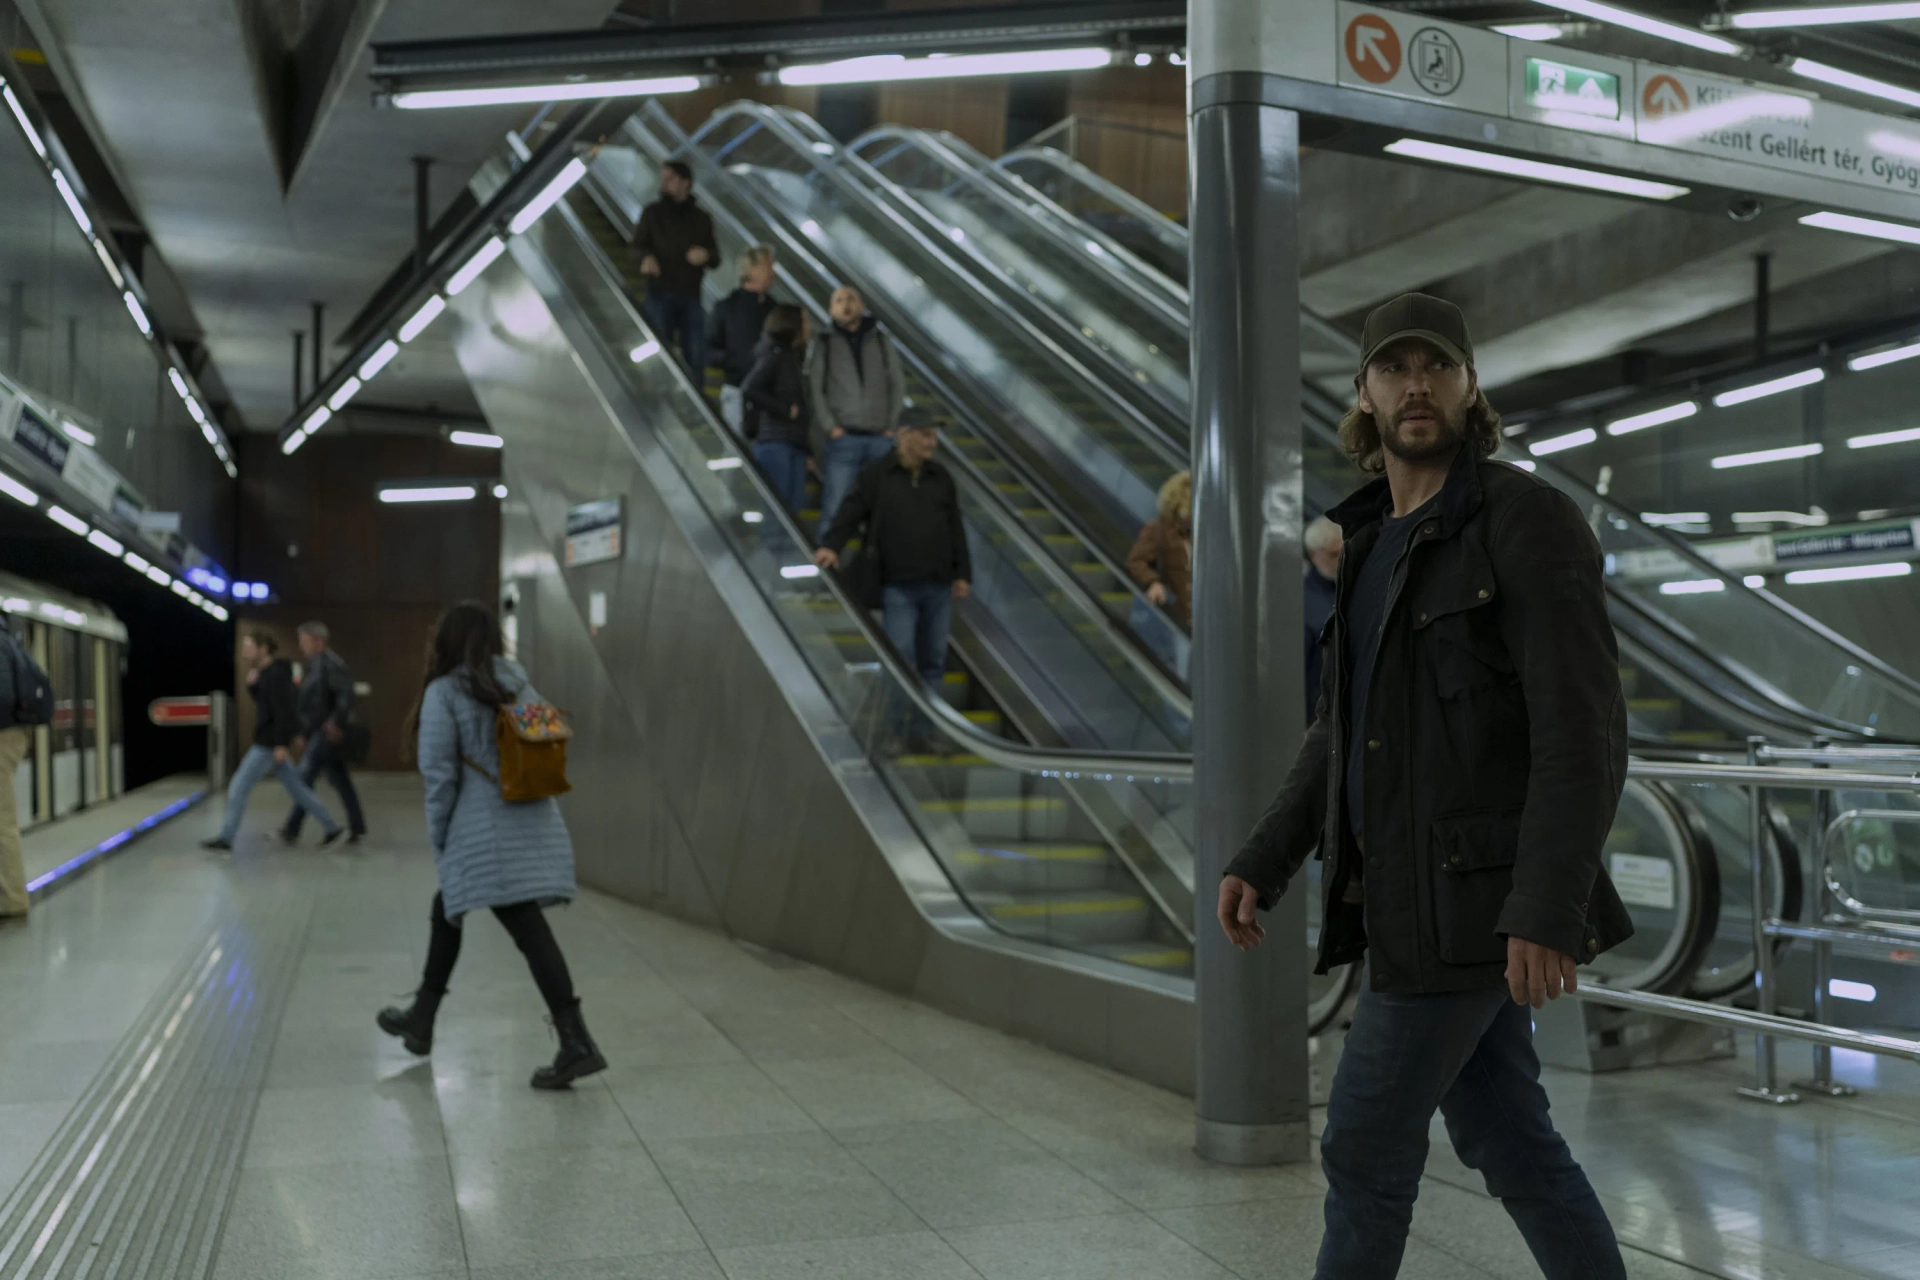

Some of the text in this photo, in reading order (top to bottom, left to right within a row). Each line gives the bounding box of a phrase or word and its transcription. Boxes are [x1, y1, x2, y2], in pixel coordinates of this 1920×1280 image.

[1760, 133, 1826, 165] Gellért
[1834, 146, 1864, 175] tér,
[1871, 155, 1920, 188] Gyóg
